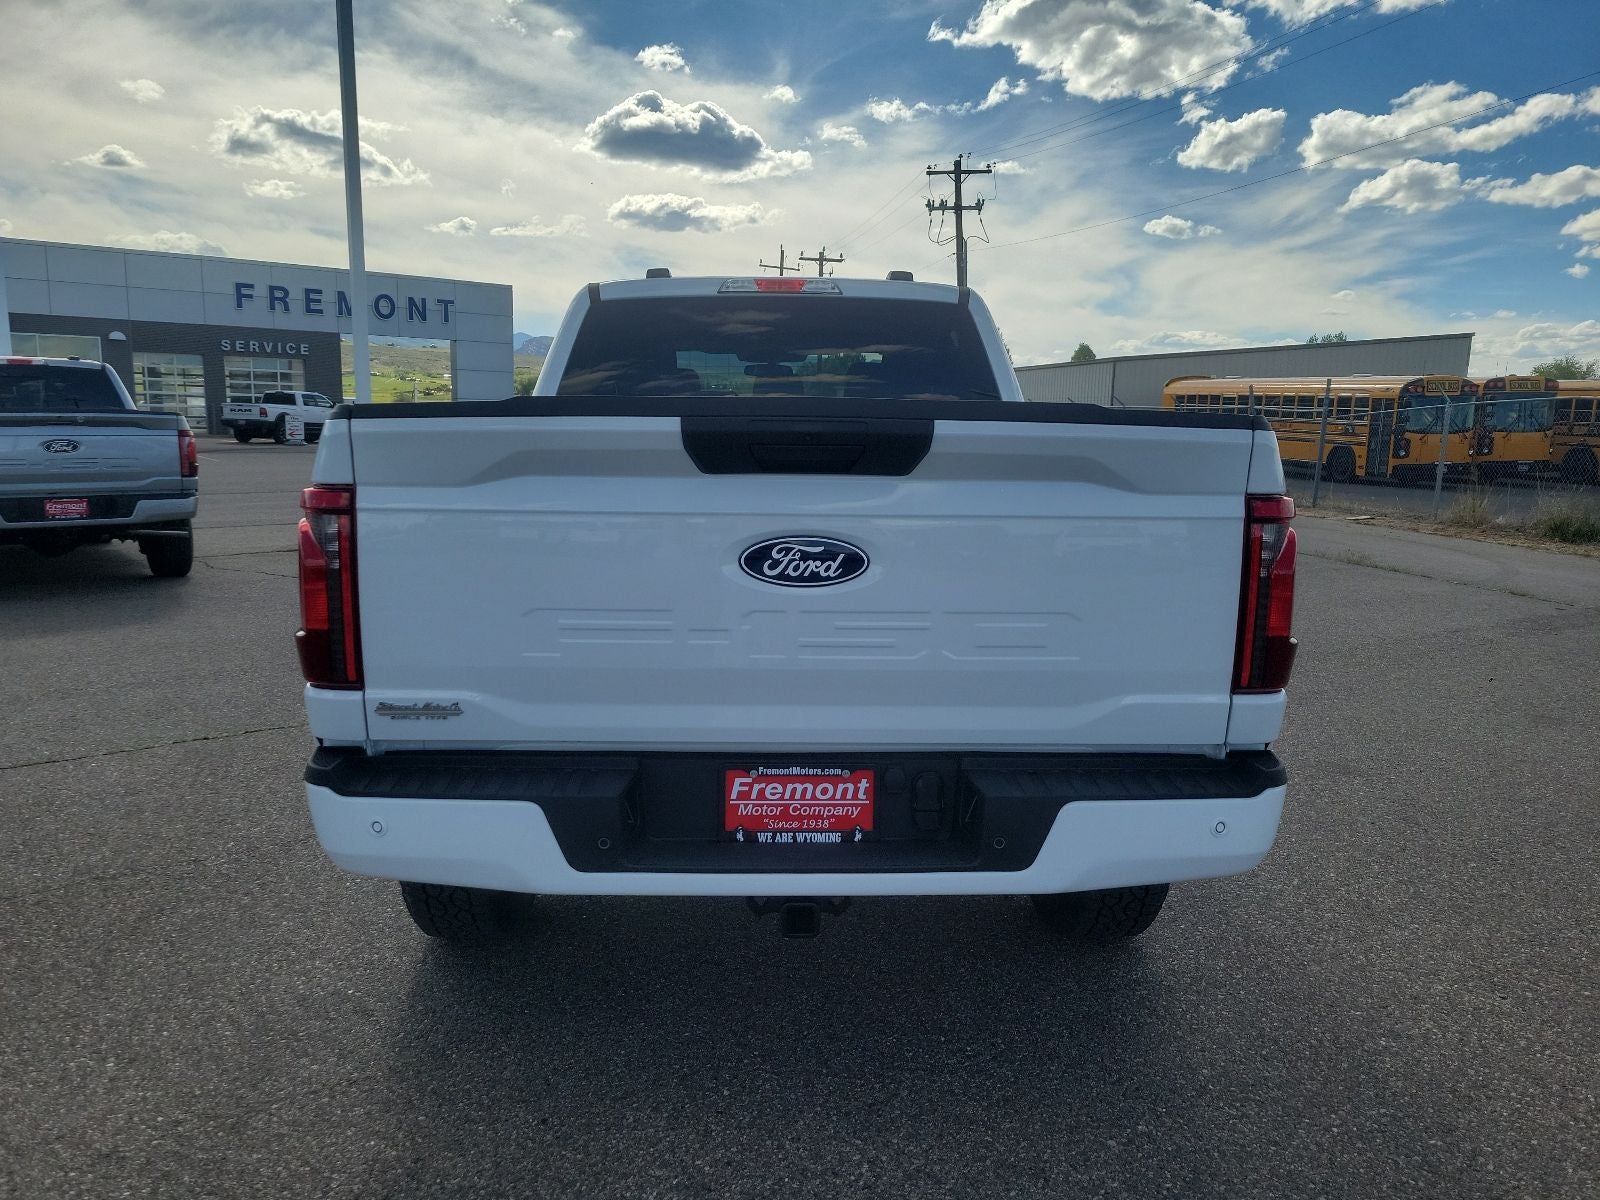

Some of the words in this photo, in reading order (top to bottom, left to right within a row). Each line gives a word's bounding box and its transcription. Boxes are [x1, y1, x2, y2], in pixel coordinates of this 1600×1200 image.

[220, 339, 310, 355] SERVICE
[1448, 381, 1459, 391] BUS
[50, 441, 73, 450] Ford
[763, 543, 844, 579] Ford
[758, 767, 842, 776] FremontMotors.com
[730, 777, 870, 801] Fremont
[738, 804, 784, 816] Motor
[789, 804, 861, 818] Company
[757, 832, 774, 843] WE
[775, 832, 795, 843] ARE
[796, 832, 842, 843] WYOMING
